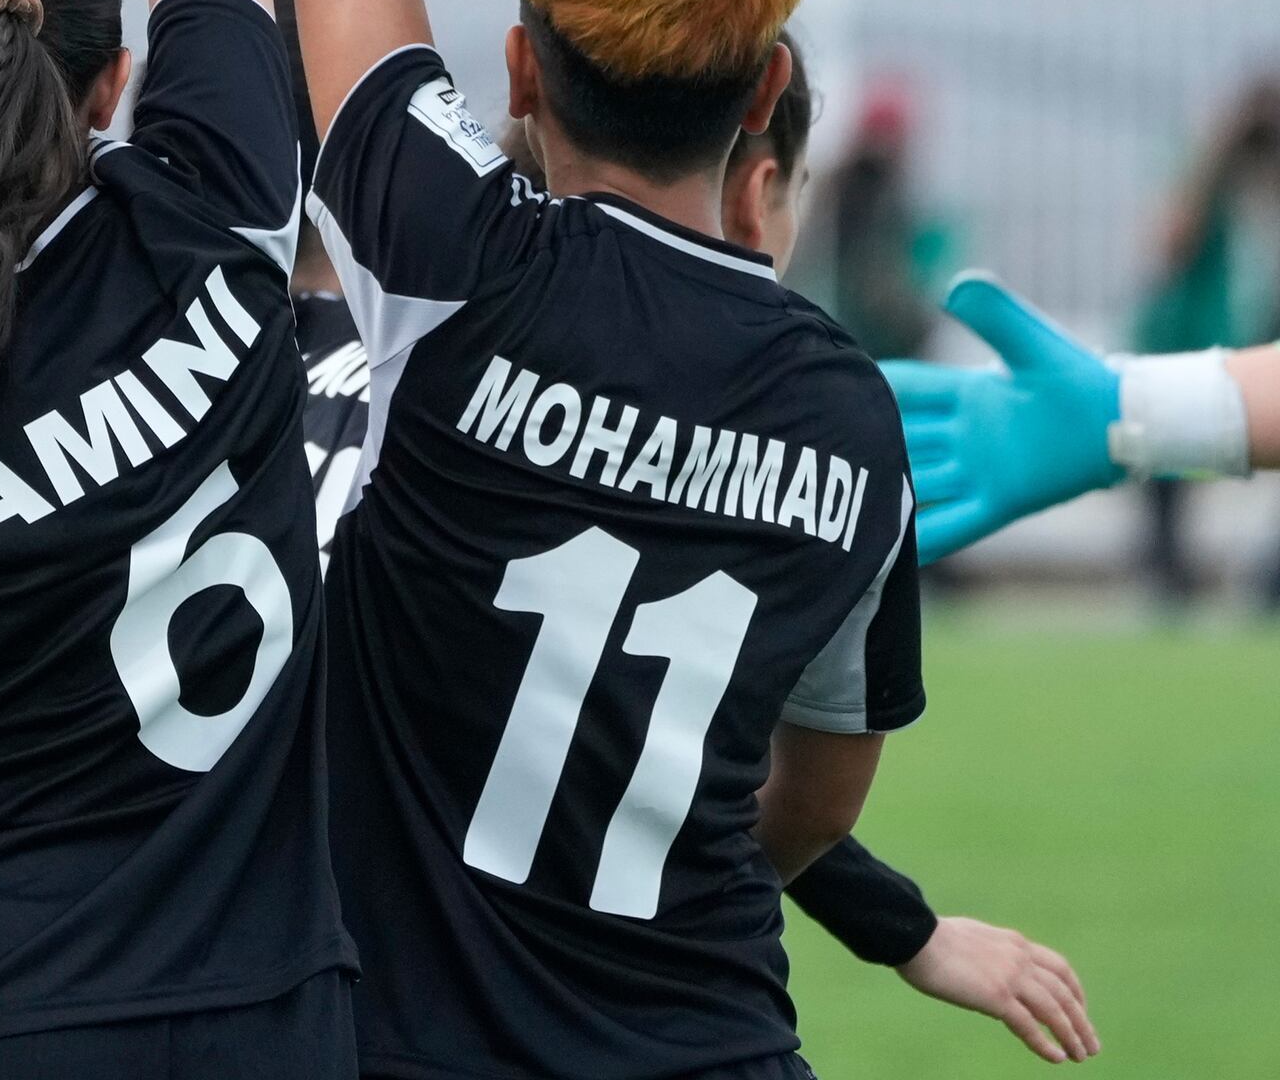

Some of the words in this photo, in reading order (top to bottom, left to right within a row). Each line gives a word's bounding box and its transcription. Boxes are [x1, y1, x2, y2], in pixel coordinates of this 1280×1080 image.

[456, 355, 869, 553] MOHAMMADI
[109, 459, 294, 772] 6
[462, 525, 759, 920] 11
